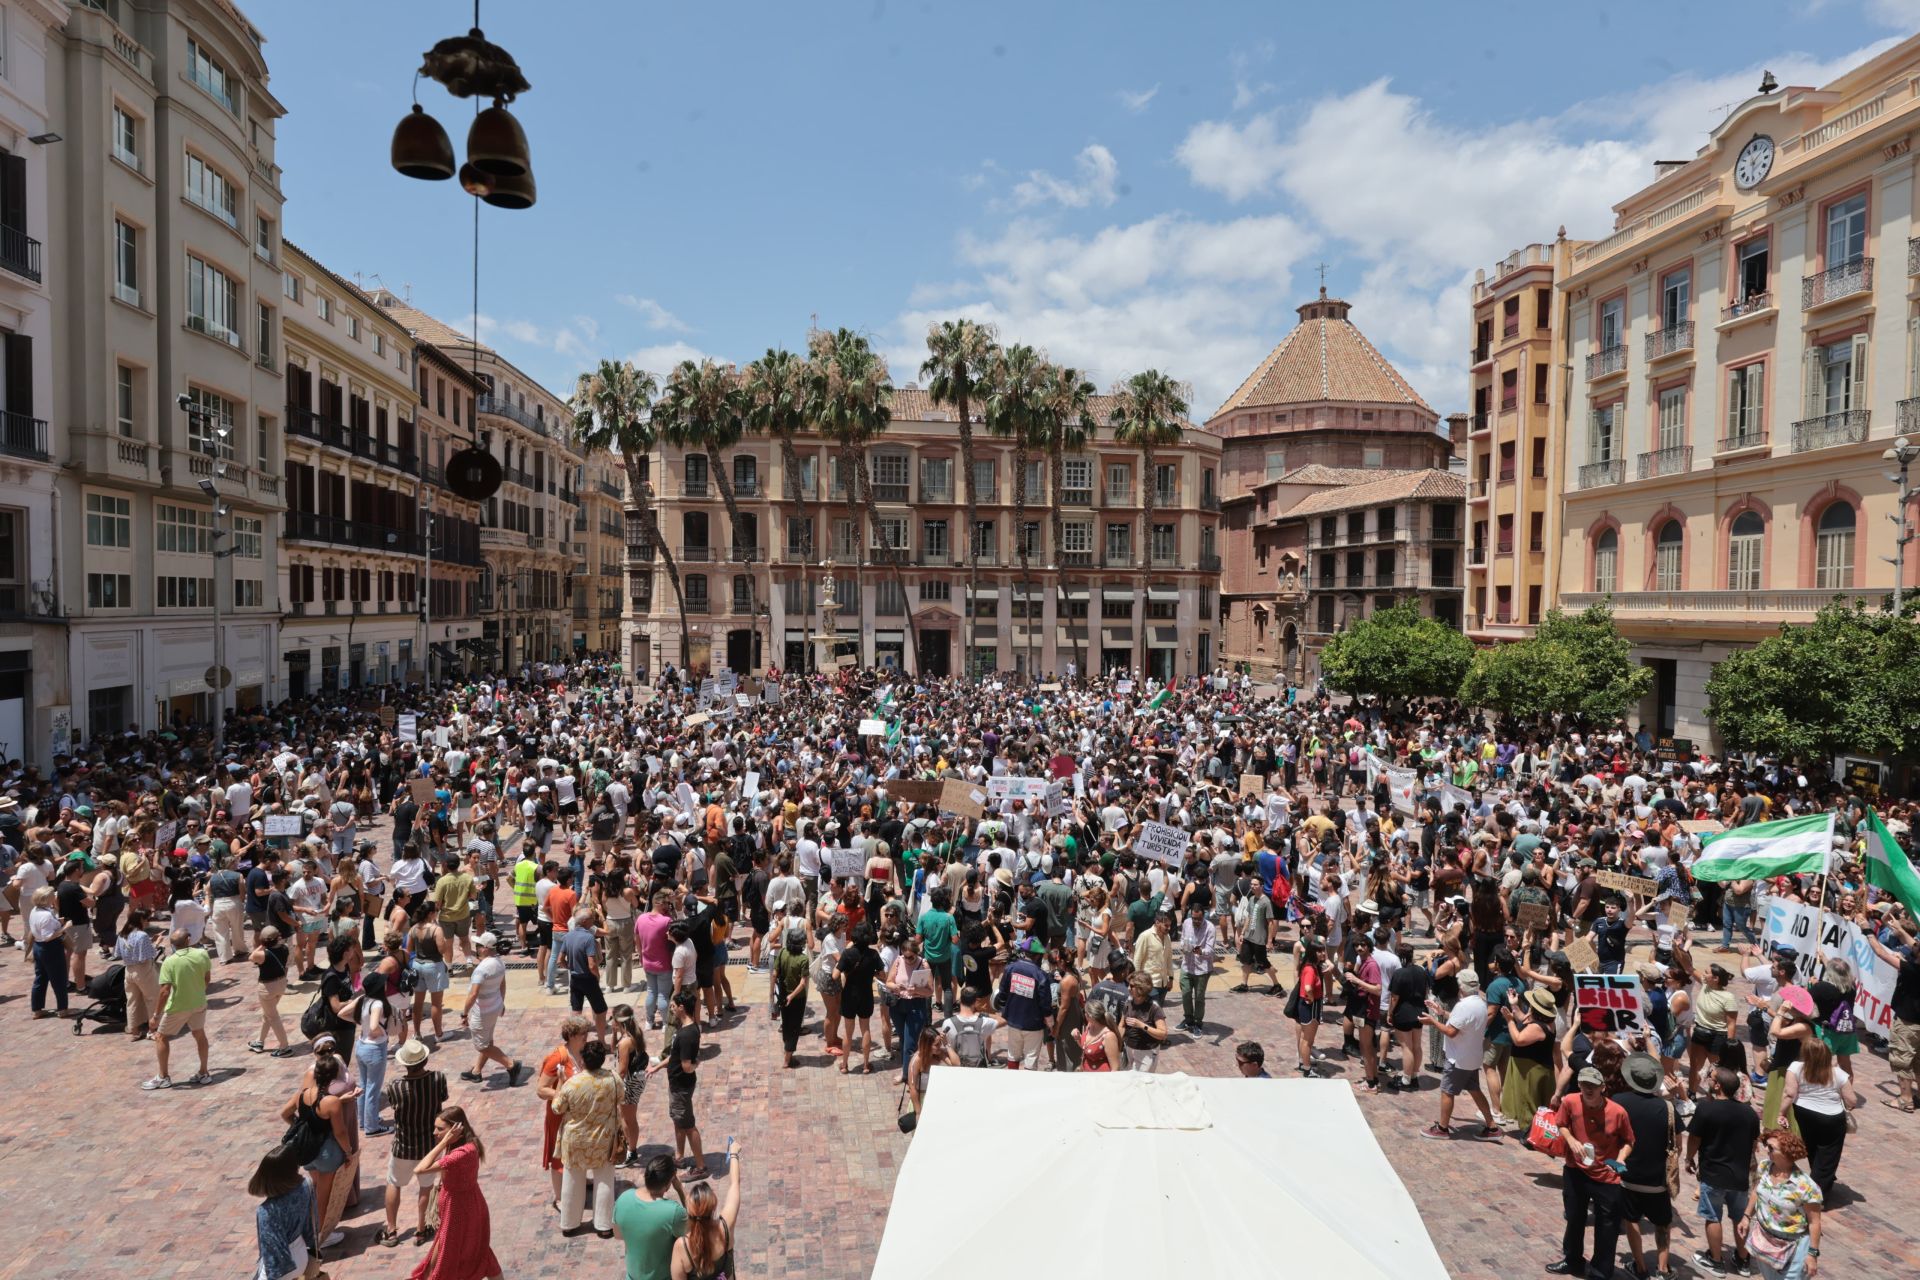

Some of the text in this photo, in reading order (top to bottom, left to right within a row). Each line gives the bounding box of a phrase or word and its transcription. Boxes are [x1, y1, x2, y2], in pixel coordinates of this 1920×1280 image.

[1149, 833, 1182, 849] VIVIENDA
[1790, 914, 1810, 938] NO
[1577, 976, 1635, 989] AL
